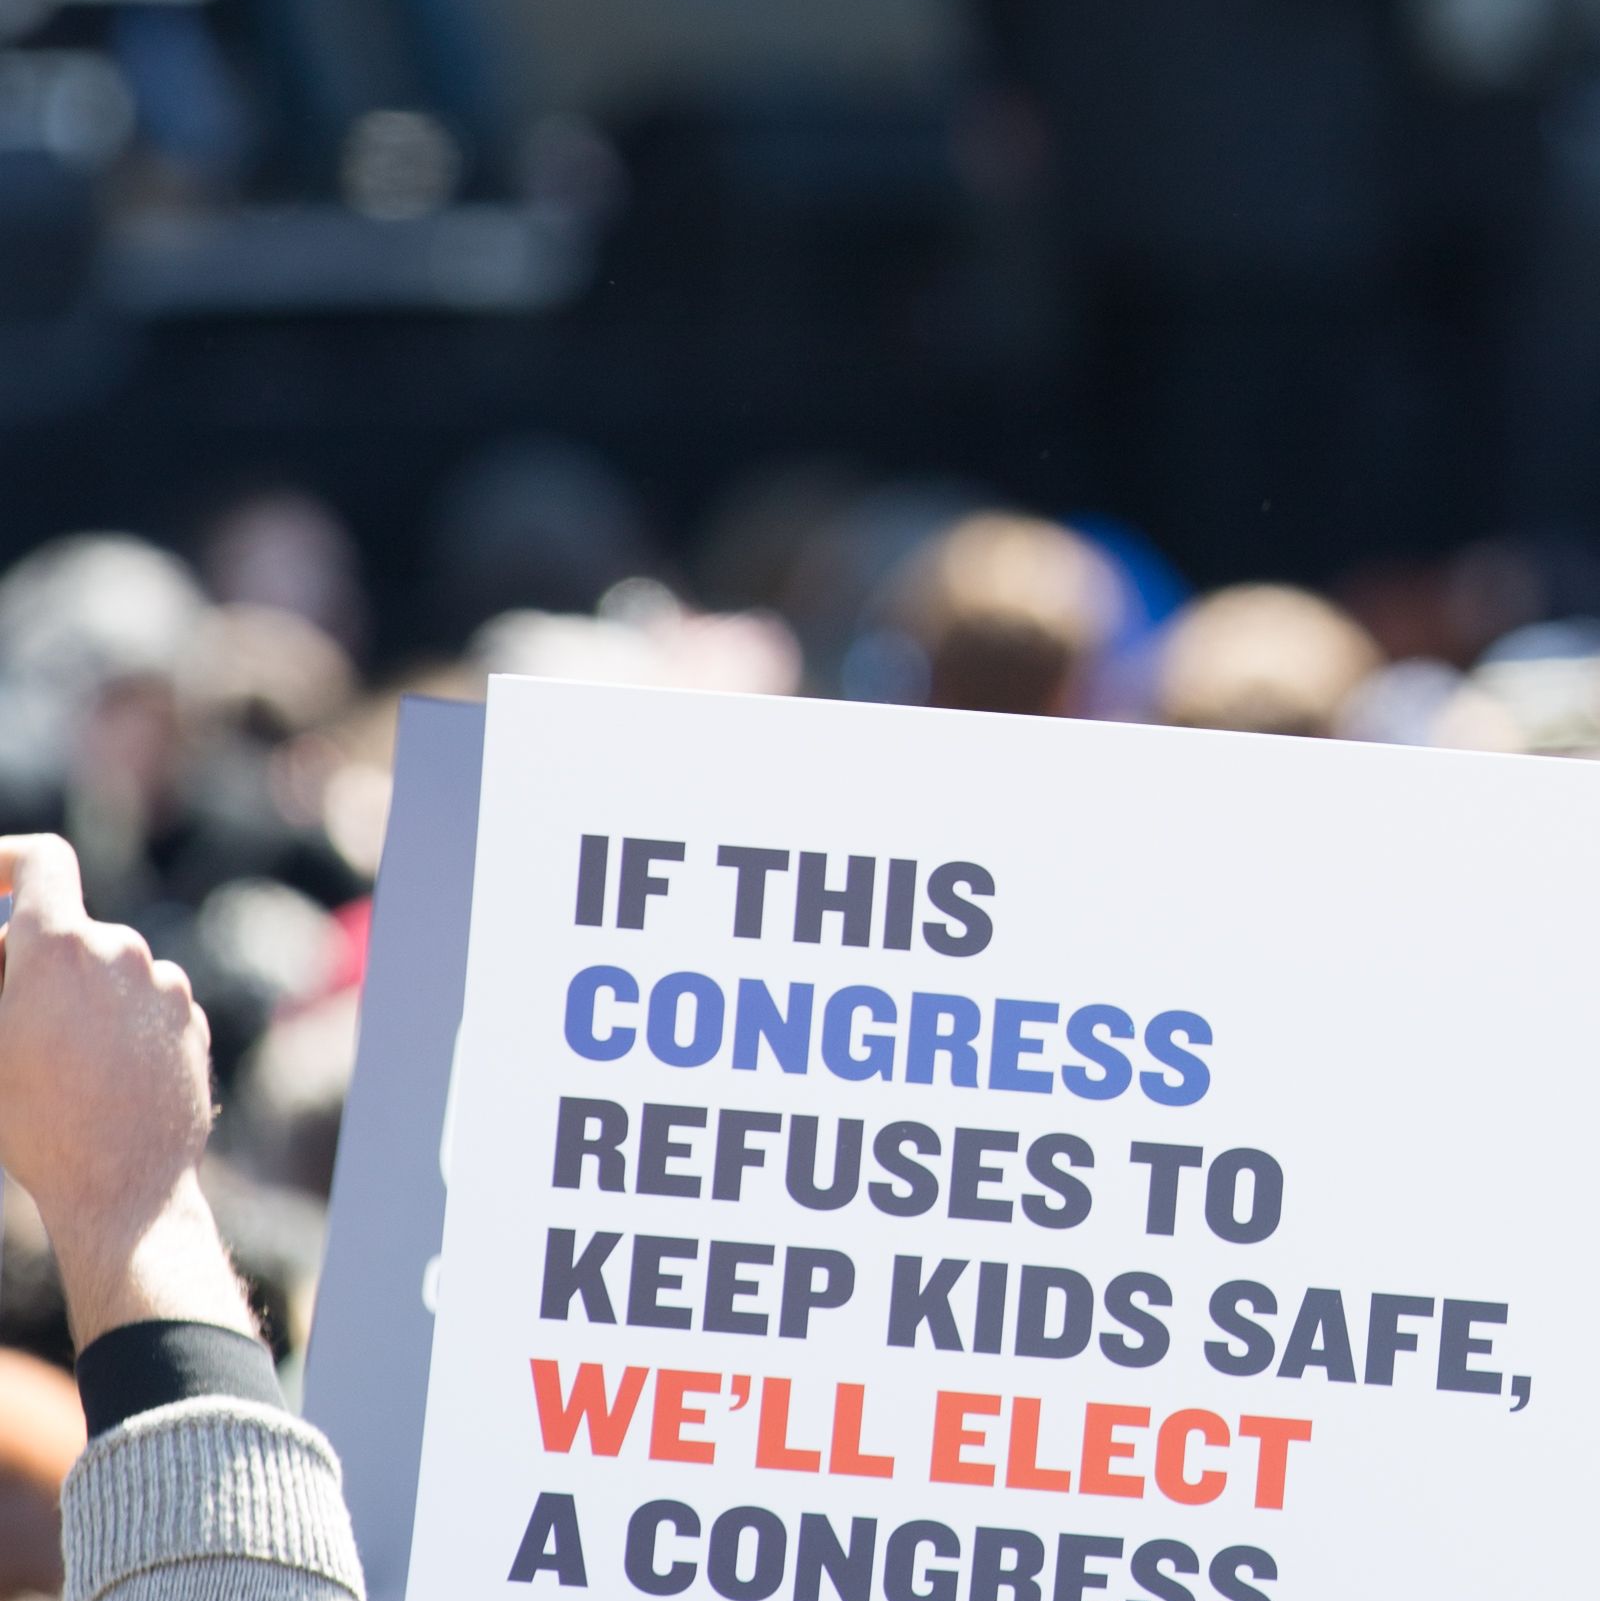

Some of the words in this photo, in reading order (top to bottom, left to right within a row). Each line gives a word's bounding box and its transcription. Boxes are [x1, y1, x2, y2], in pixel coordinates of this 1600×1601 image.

[575, 834, 685, 930] IF
[717, 845, 995, 957] THIS
[565, 965, 1212, 1106] CONGRESS
[552, 1096, 1094, 1229] REFUSES
[1130, 1141, 1283, 1244] TO
[540, 1228, 855, 1339] KEEP
[887, 1255, 1172, 1368] KIDS
[1204, 1280, 1531, 1412] SAFE,
[530, 1359, 894, 1478] WE’LL
[930, 1391, 1312, 1509] ELECT
[507, 1492, 588, 1587] A
